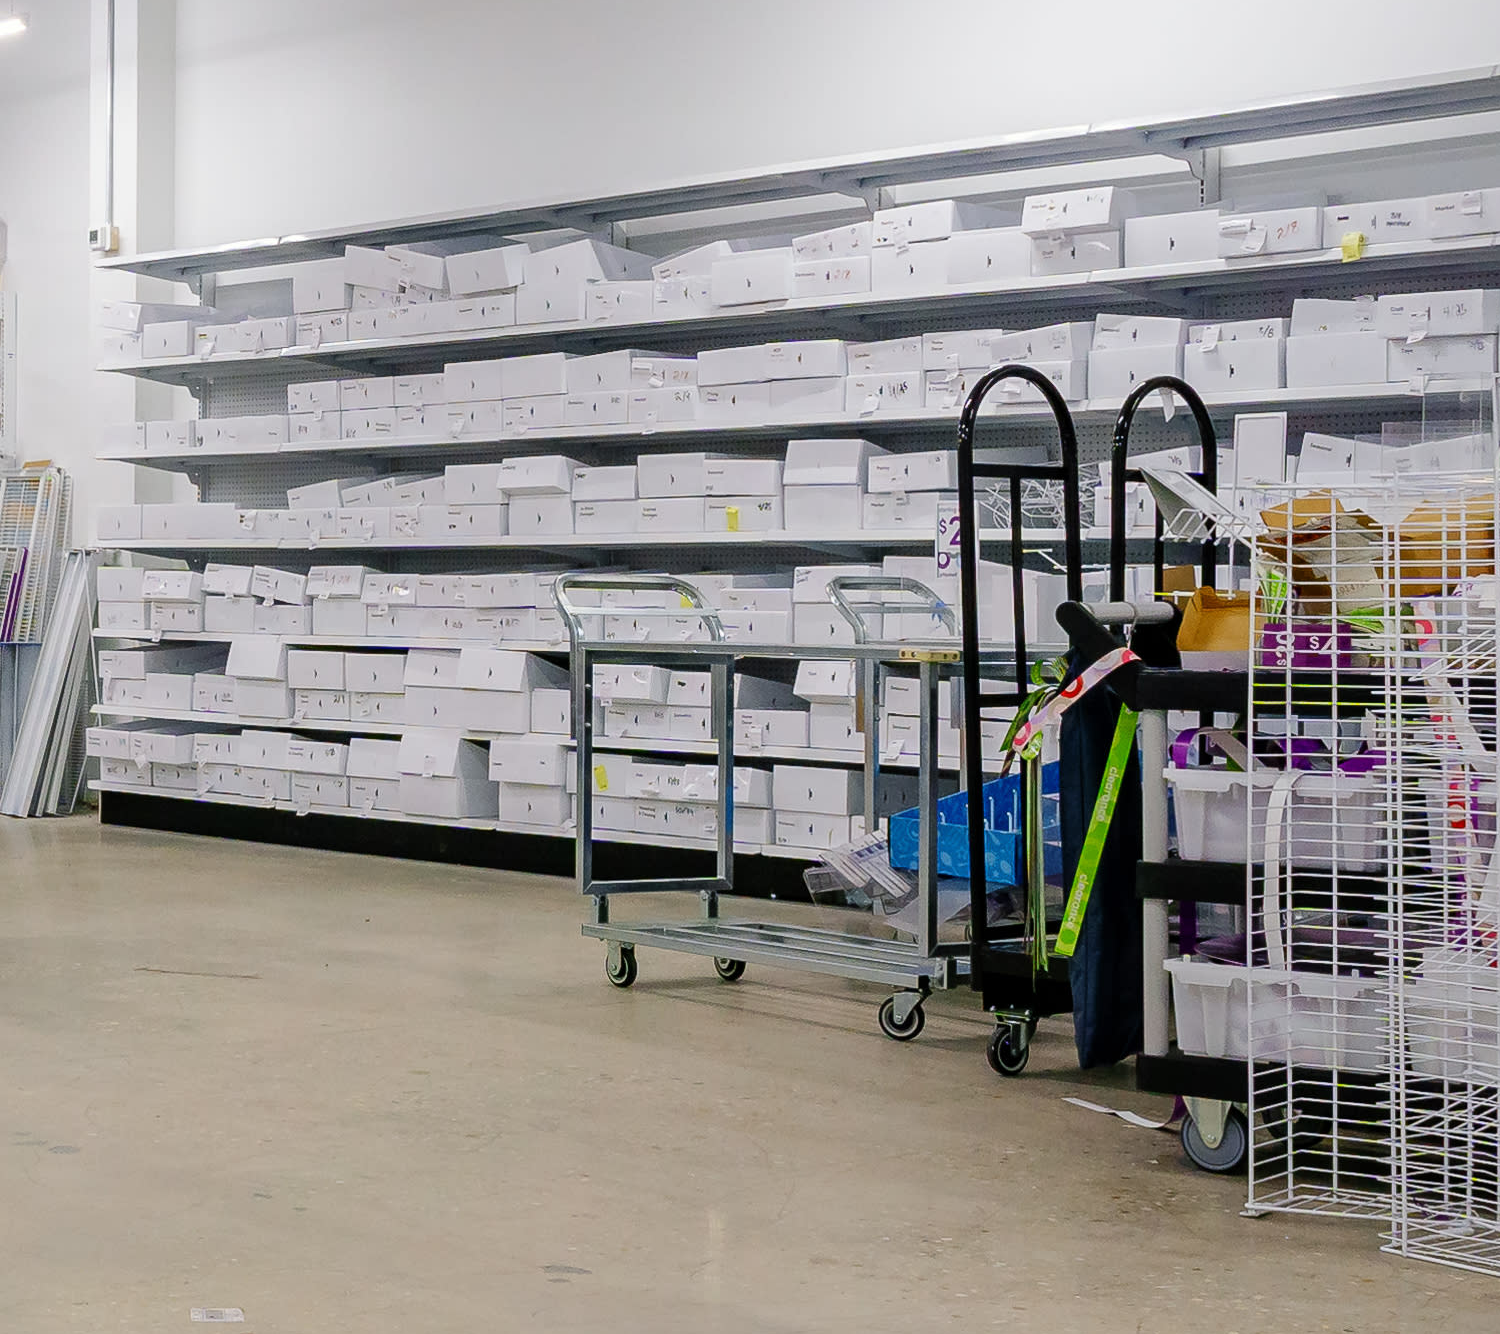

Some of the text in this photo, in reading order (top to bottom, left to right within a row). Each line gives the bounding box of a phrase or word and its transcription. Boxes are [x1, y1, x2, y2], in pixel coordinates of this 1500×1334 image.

[939, 515, 962, 546] $2
[1096, 766, 1120, 823] clearance
[1065, 873, 1089, 931] clearance
